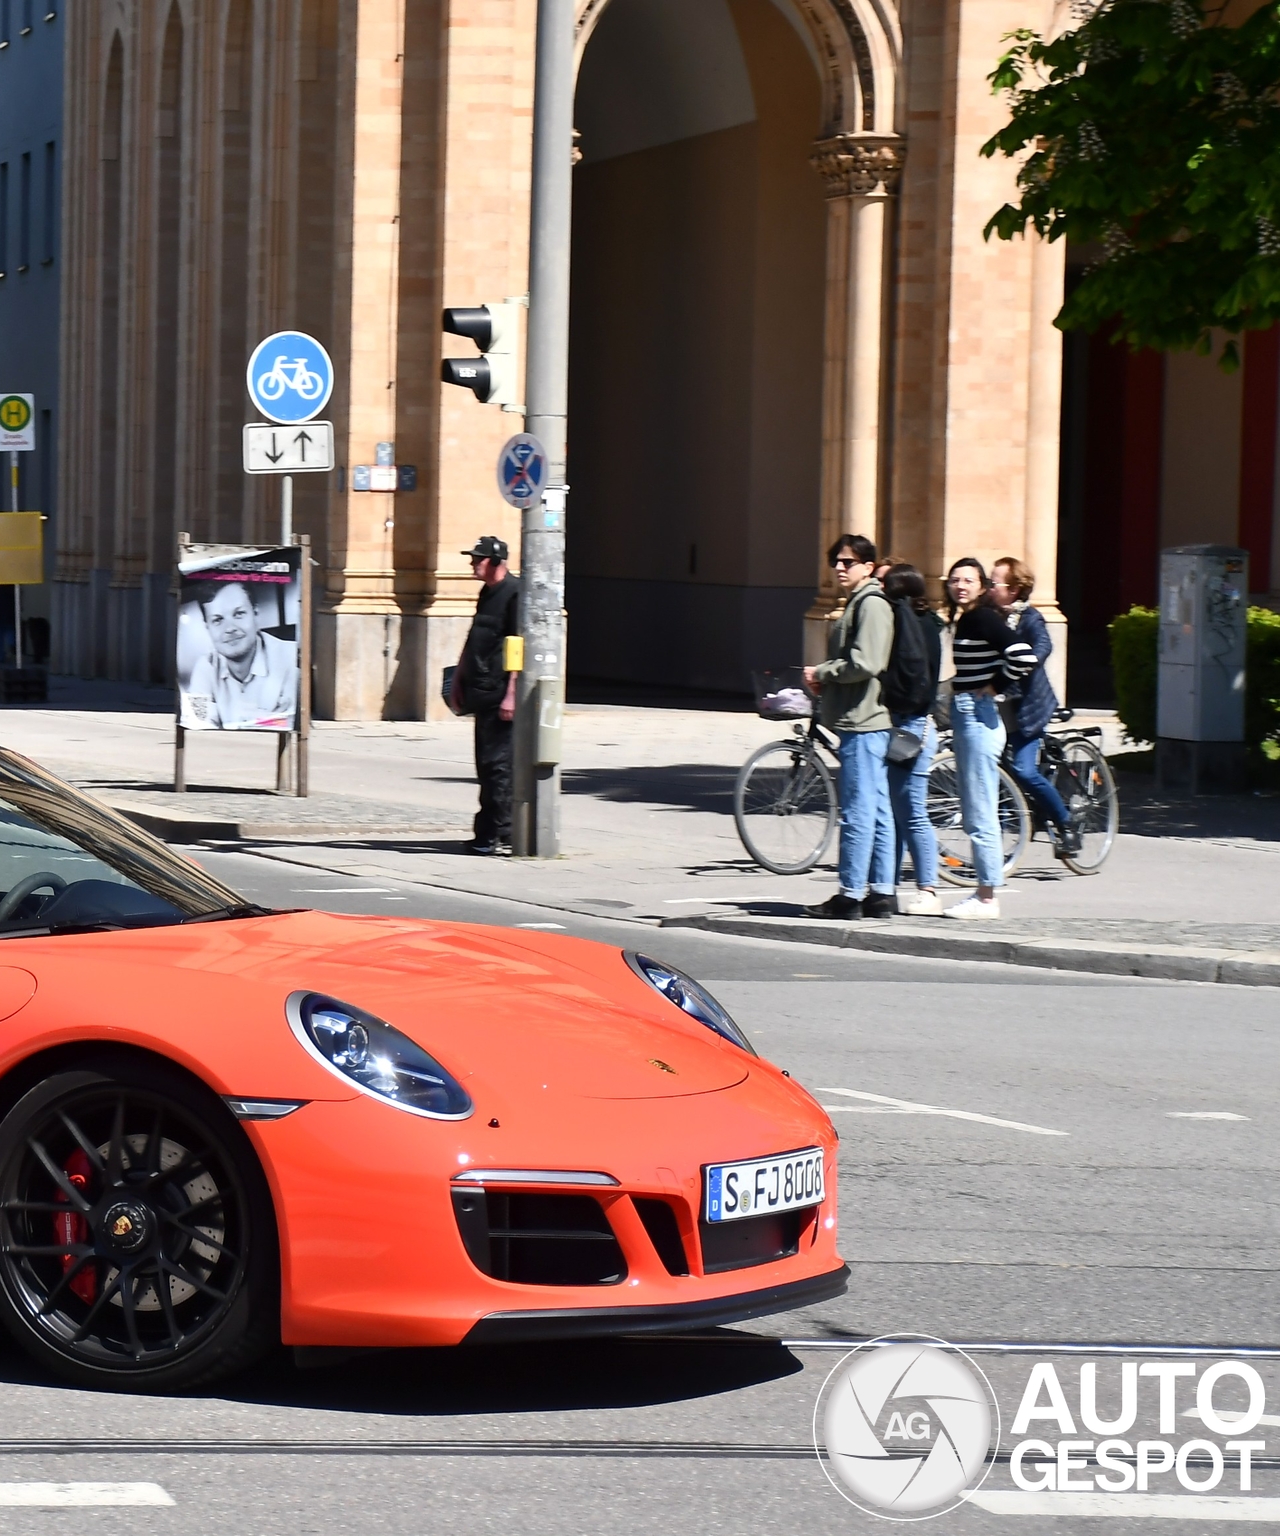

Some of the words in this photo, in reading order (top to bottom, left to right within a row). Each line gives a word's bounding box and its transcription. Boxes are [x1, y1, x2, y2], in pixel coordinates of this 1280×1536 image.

[6, 403, 22, 423] H
[725, 1172, 739, 1213] S
[711, 1200, 719, 1212] D
